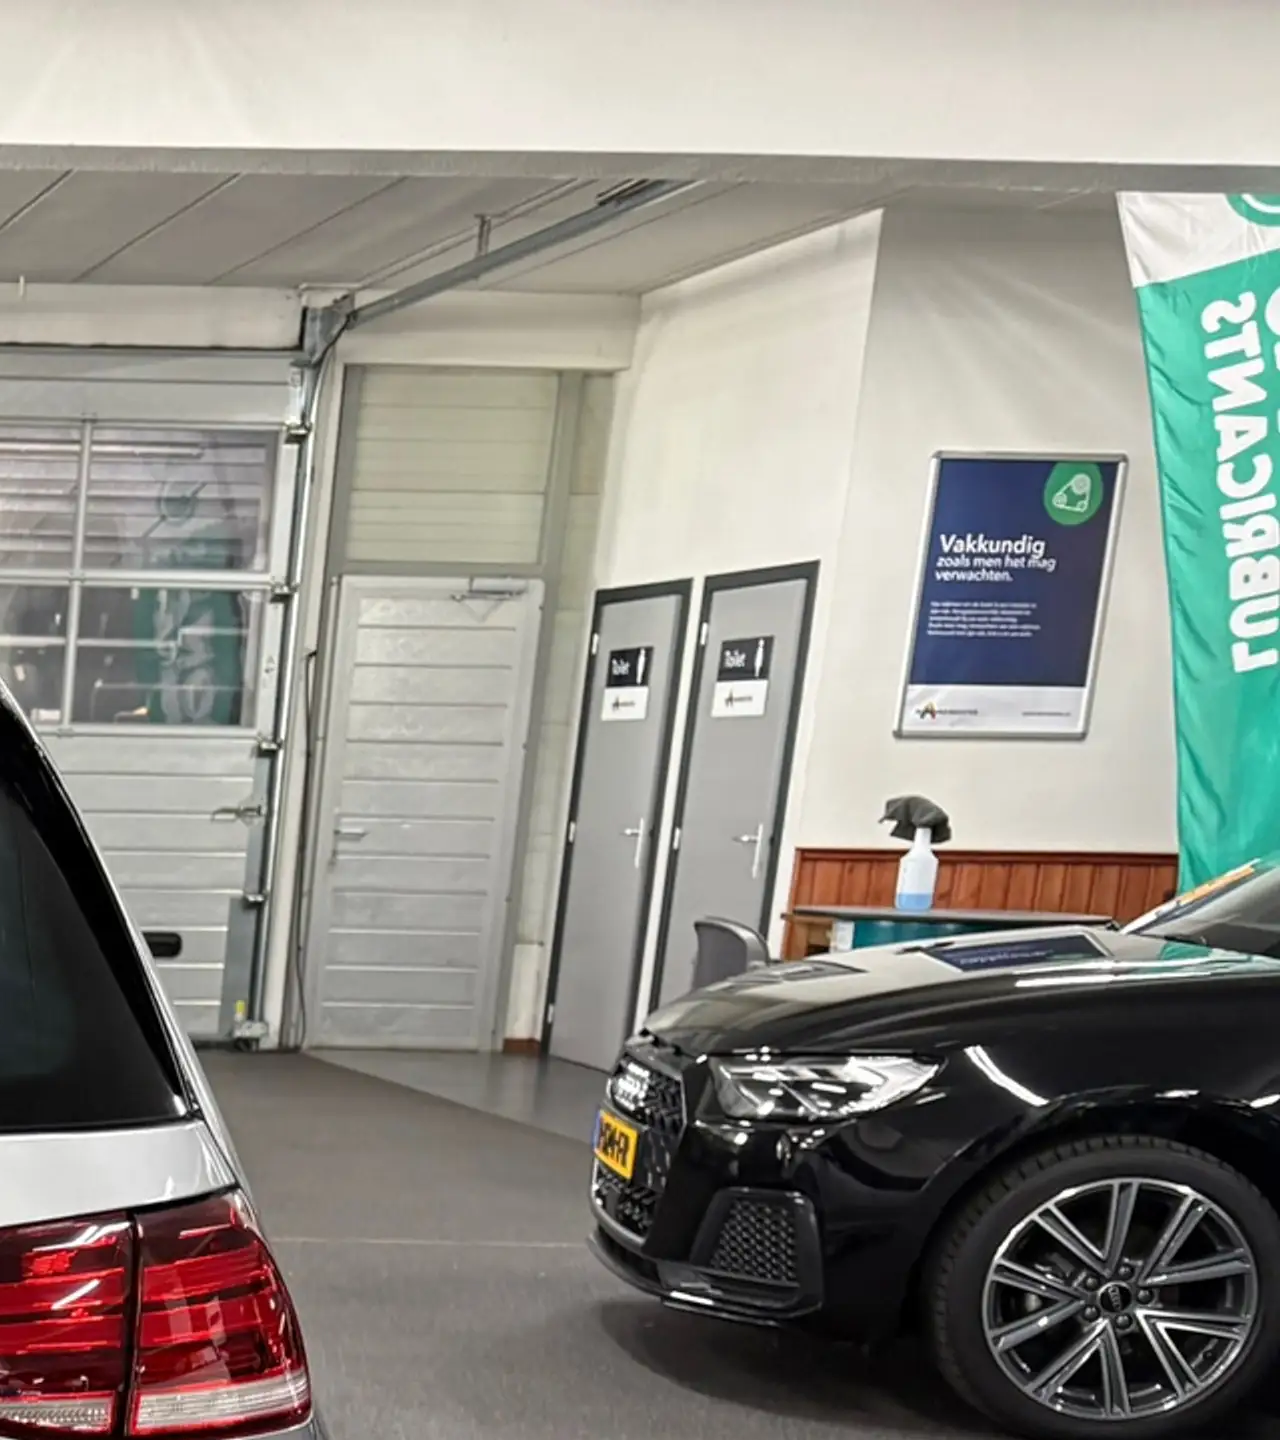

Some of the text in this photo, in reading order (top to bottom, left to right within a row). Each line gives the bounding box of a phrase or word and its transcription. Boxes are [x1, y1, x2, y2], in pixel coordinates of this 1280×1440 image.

[939, 532, 1046, 560] Vakkundig
[936, 553, 1056, 573] zoals men het mag
